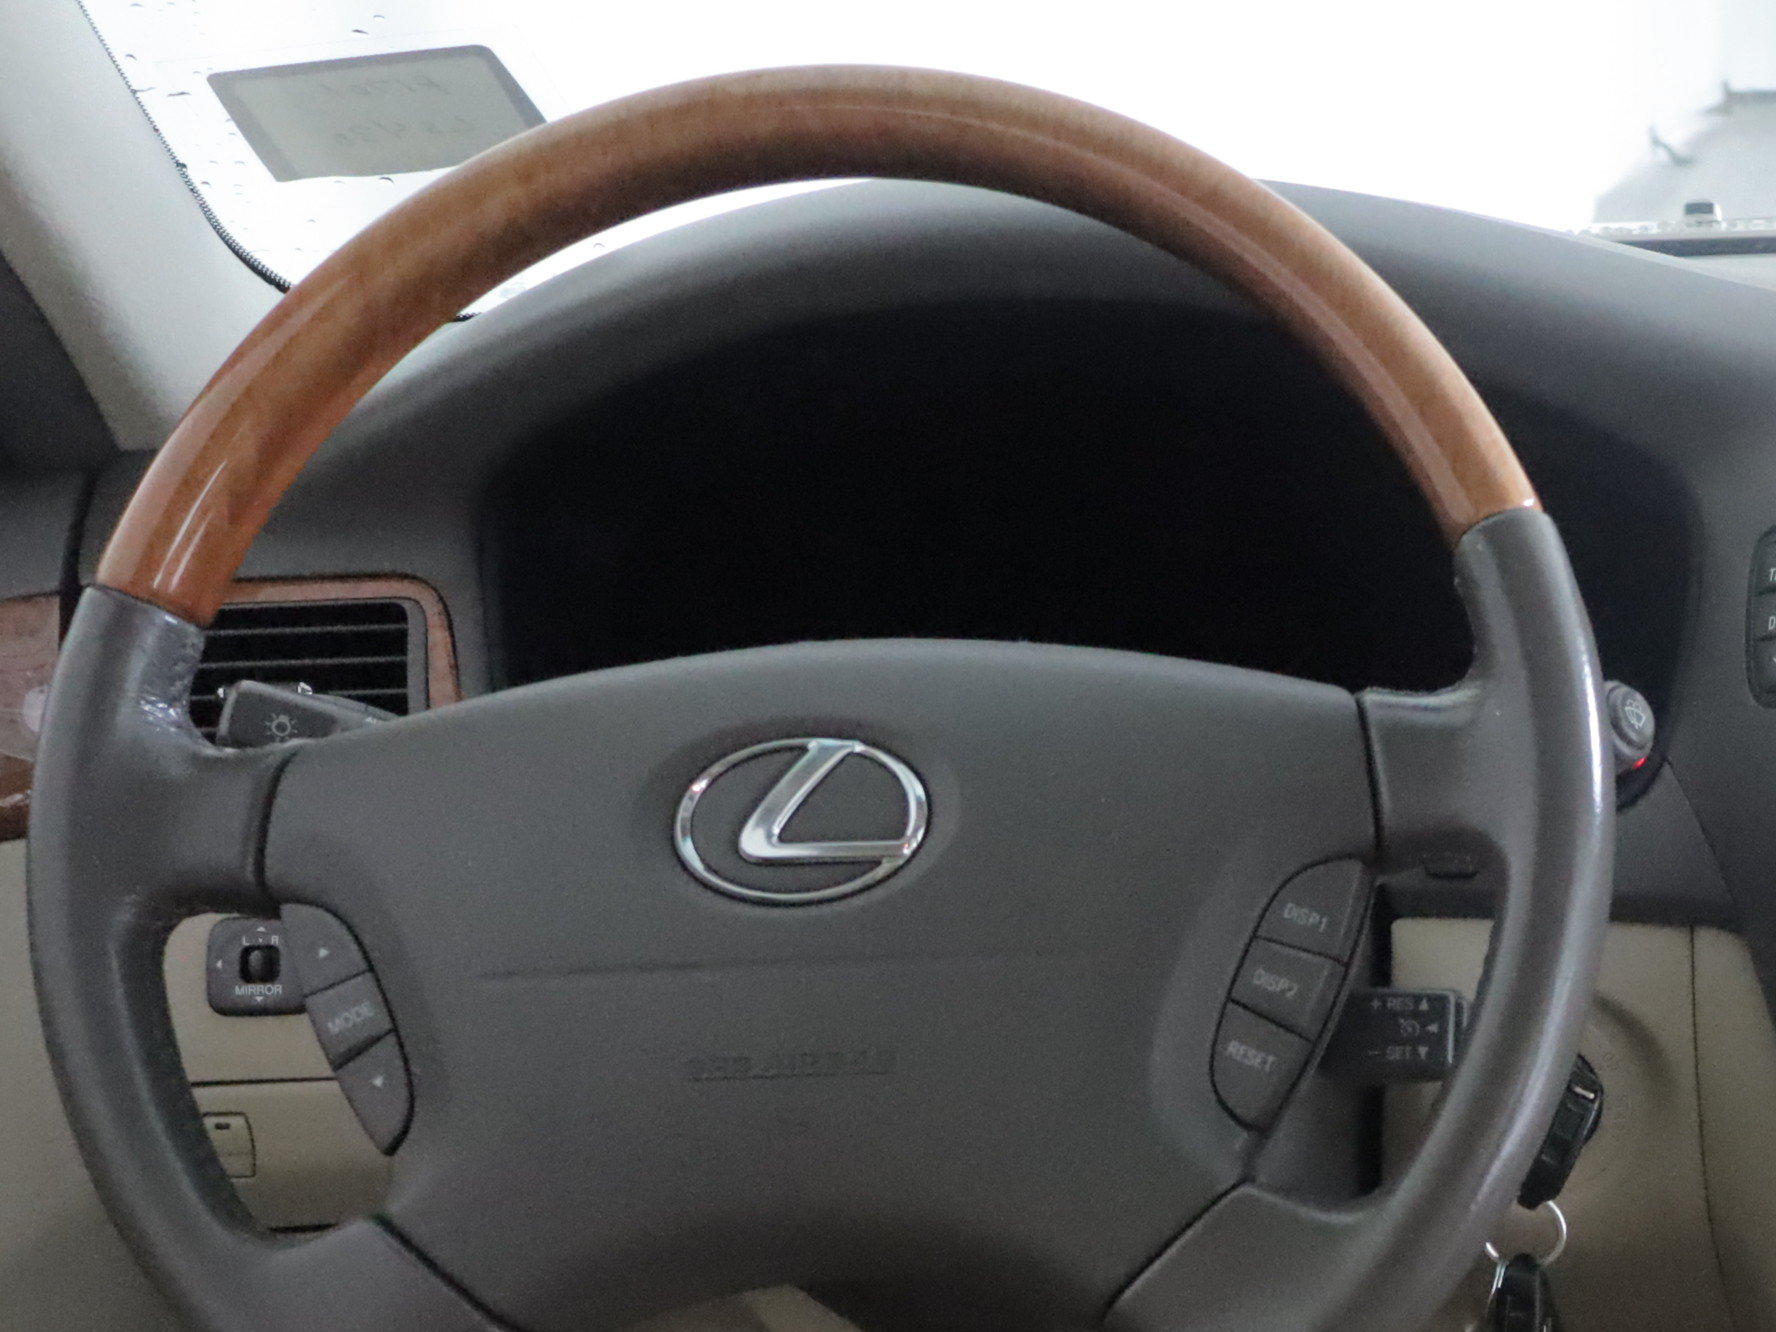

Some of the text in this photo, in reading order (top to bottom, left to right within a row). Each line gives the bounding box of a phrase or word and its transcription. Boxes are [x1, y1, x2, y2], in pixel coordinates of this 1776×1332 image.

[1281, 902, 1328, 933] DISP1
[234, 983, 283, 996] MIRROR
[1252, 969, 1298, 999] DISP2
[326, 1003, 374, 1035] MODE
[1224, 1039, 1277, 1073] RESET
